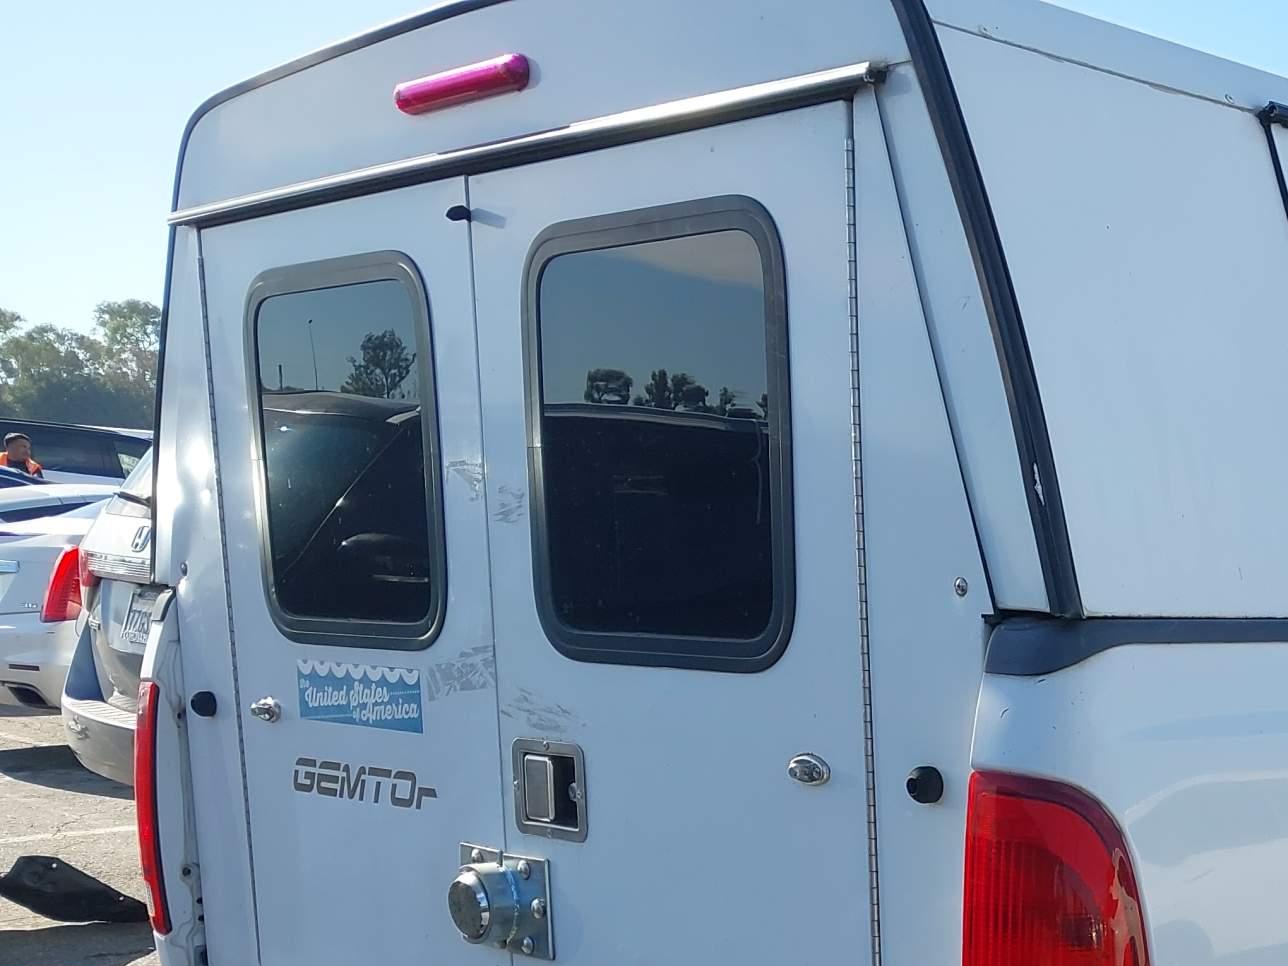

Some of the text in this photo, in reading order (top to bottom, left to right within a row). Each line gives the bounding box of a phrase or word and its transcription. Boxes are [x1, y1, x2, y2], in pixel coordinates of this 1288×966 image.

[304, 681, 390, 710] United States
[360, 698, 419, 724] America
